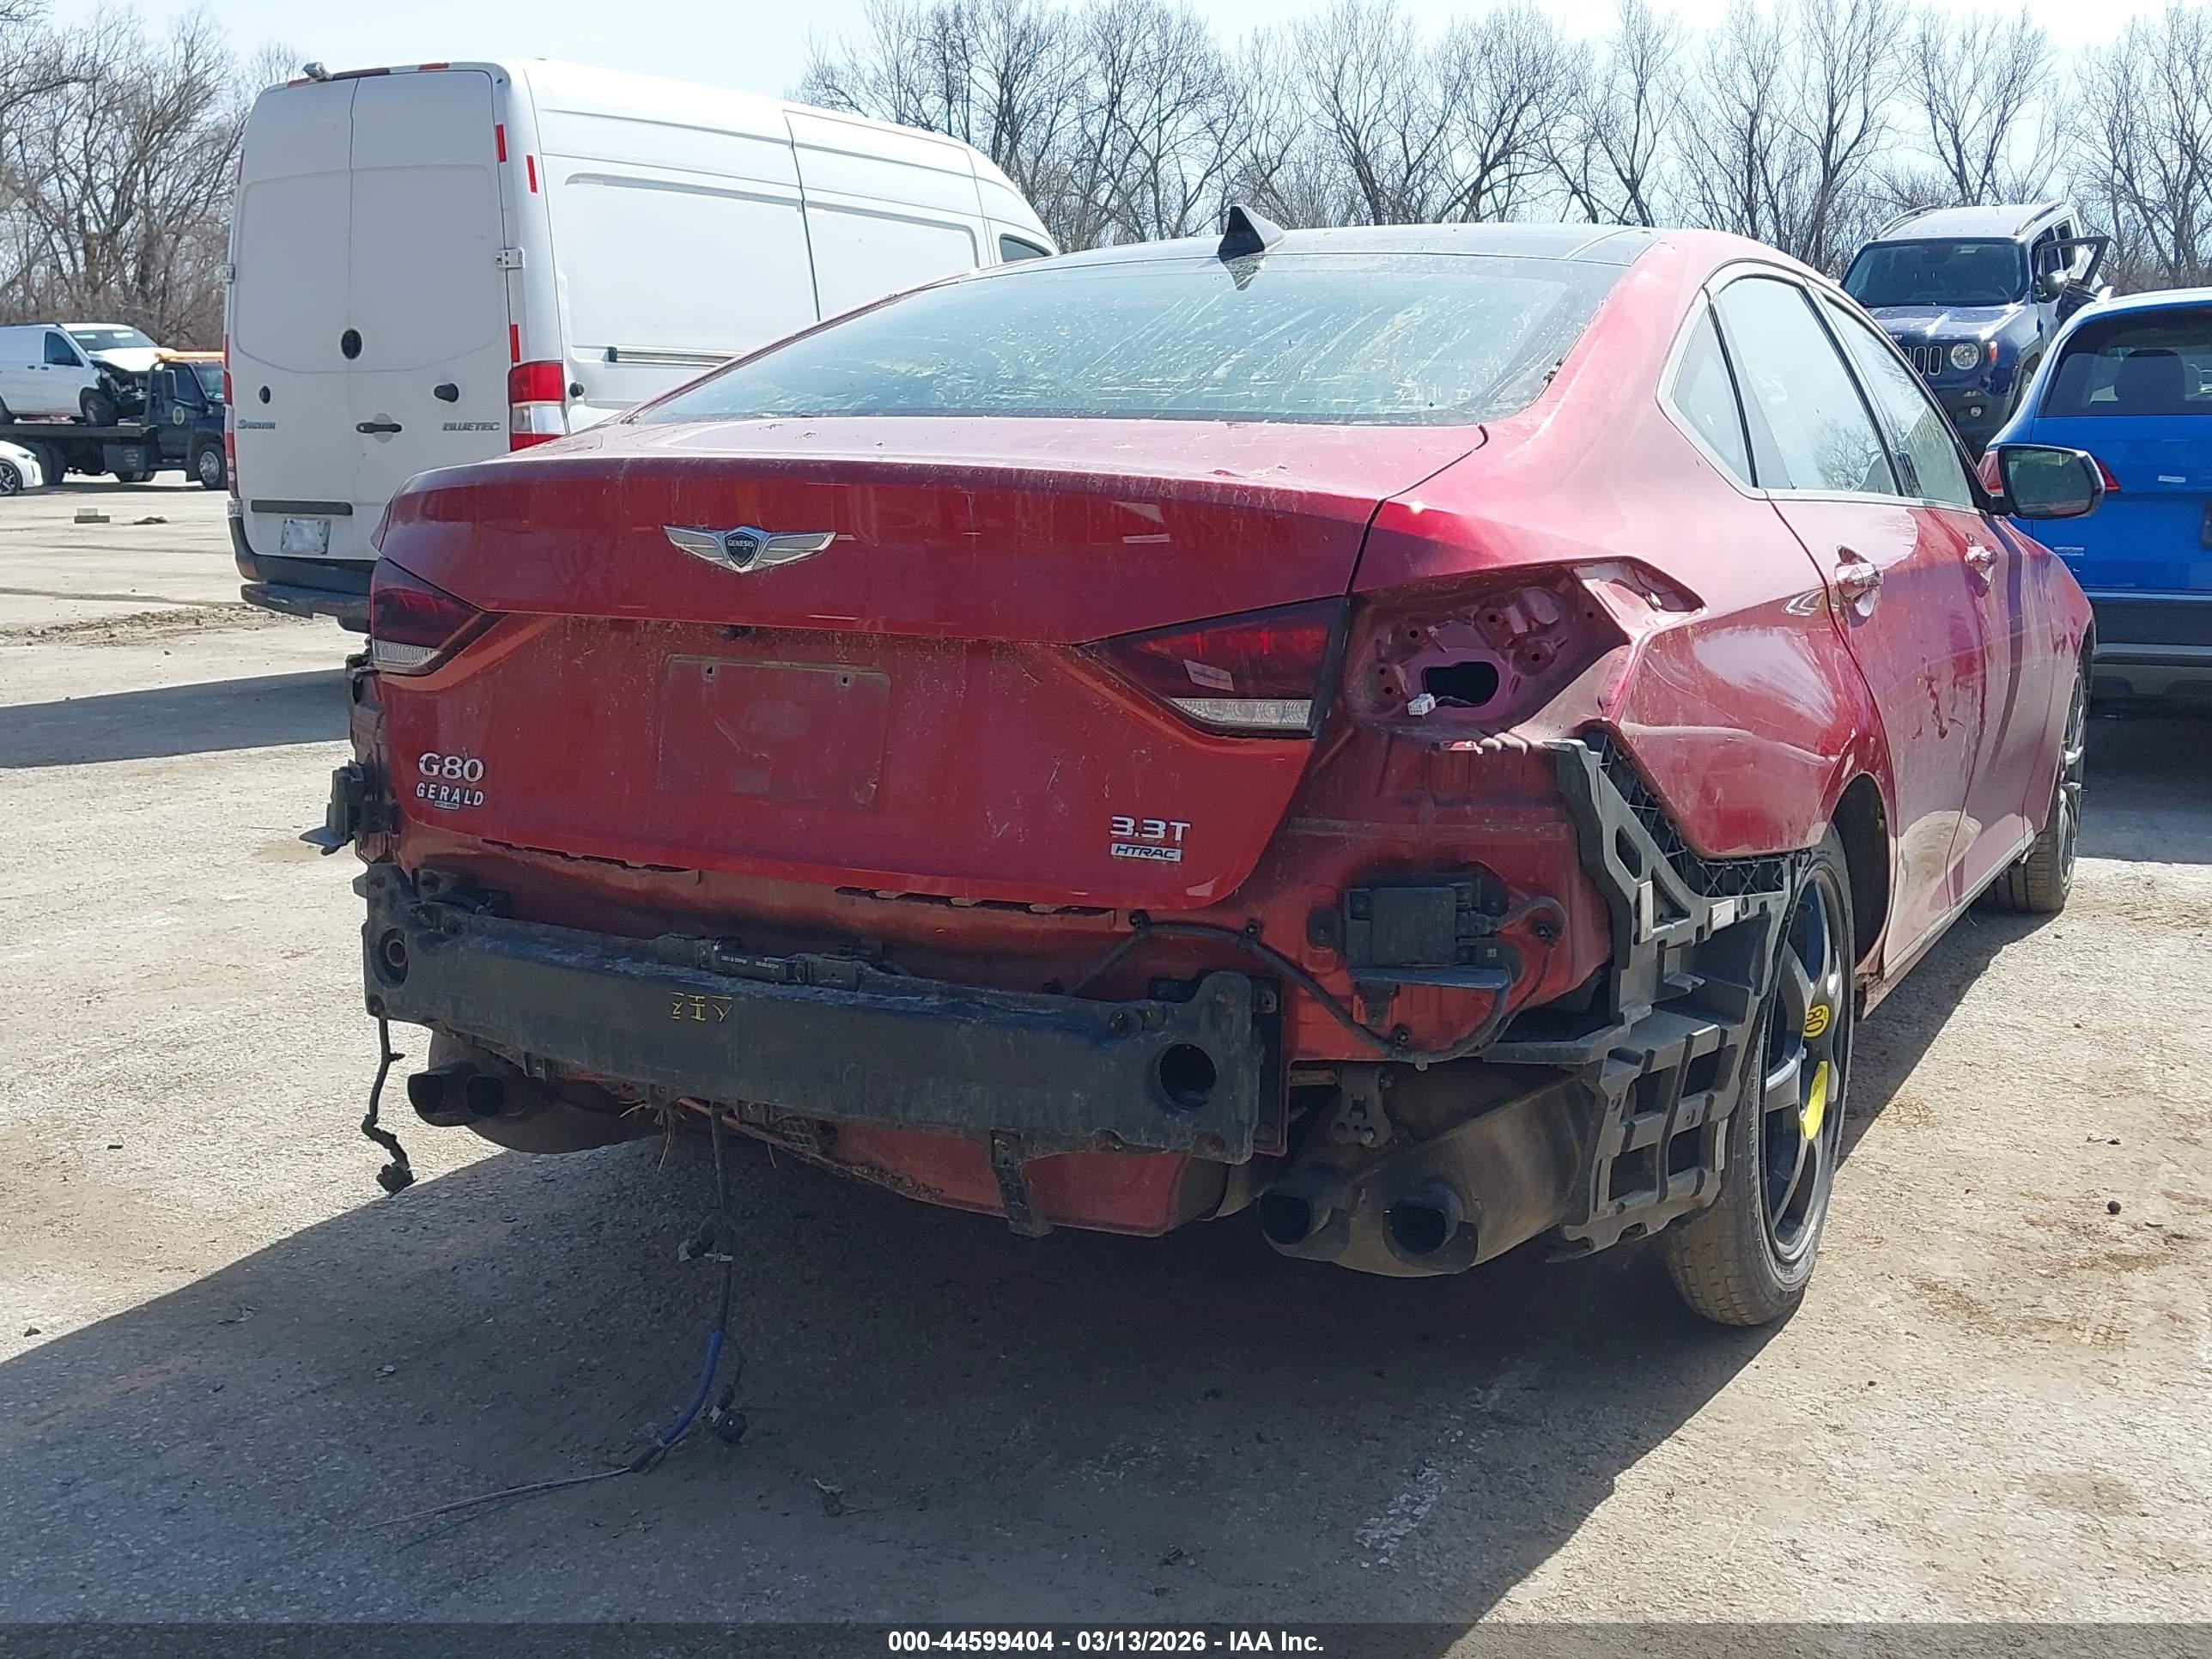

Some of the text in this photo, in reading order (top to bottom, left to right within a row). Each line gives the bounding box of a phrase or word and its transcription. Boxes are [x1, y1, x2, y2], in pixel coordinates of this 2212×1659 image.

[728, 538, 755, 549] GENESIS
[418, 752, 484, 782] G80
[416, 782, 484, 806] GERALD
[1109, 816, 1191, 842] 3.3T
[1115, 845, 1177, 860] HTRAC
